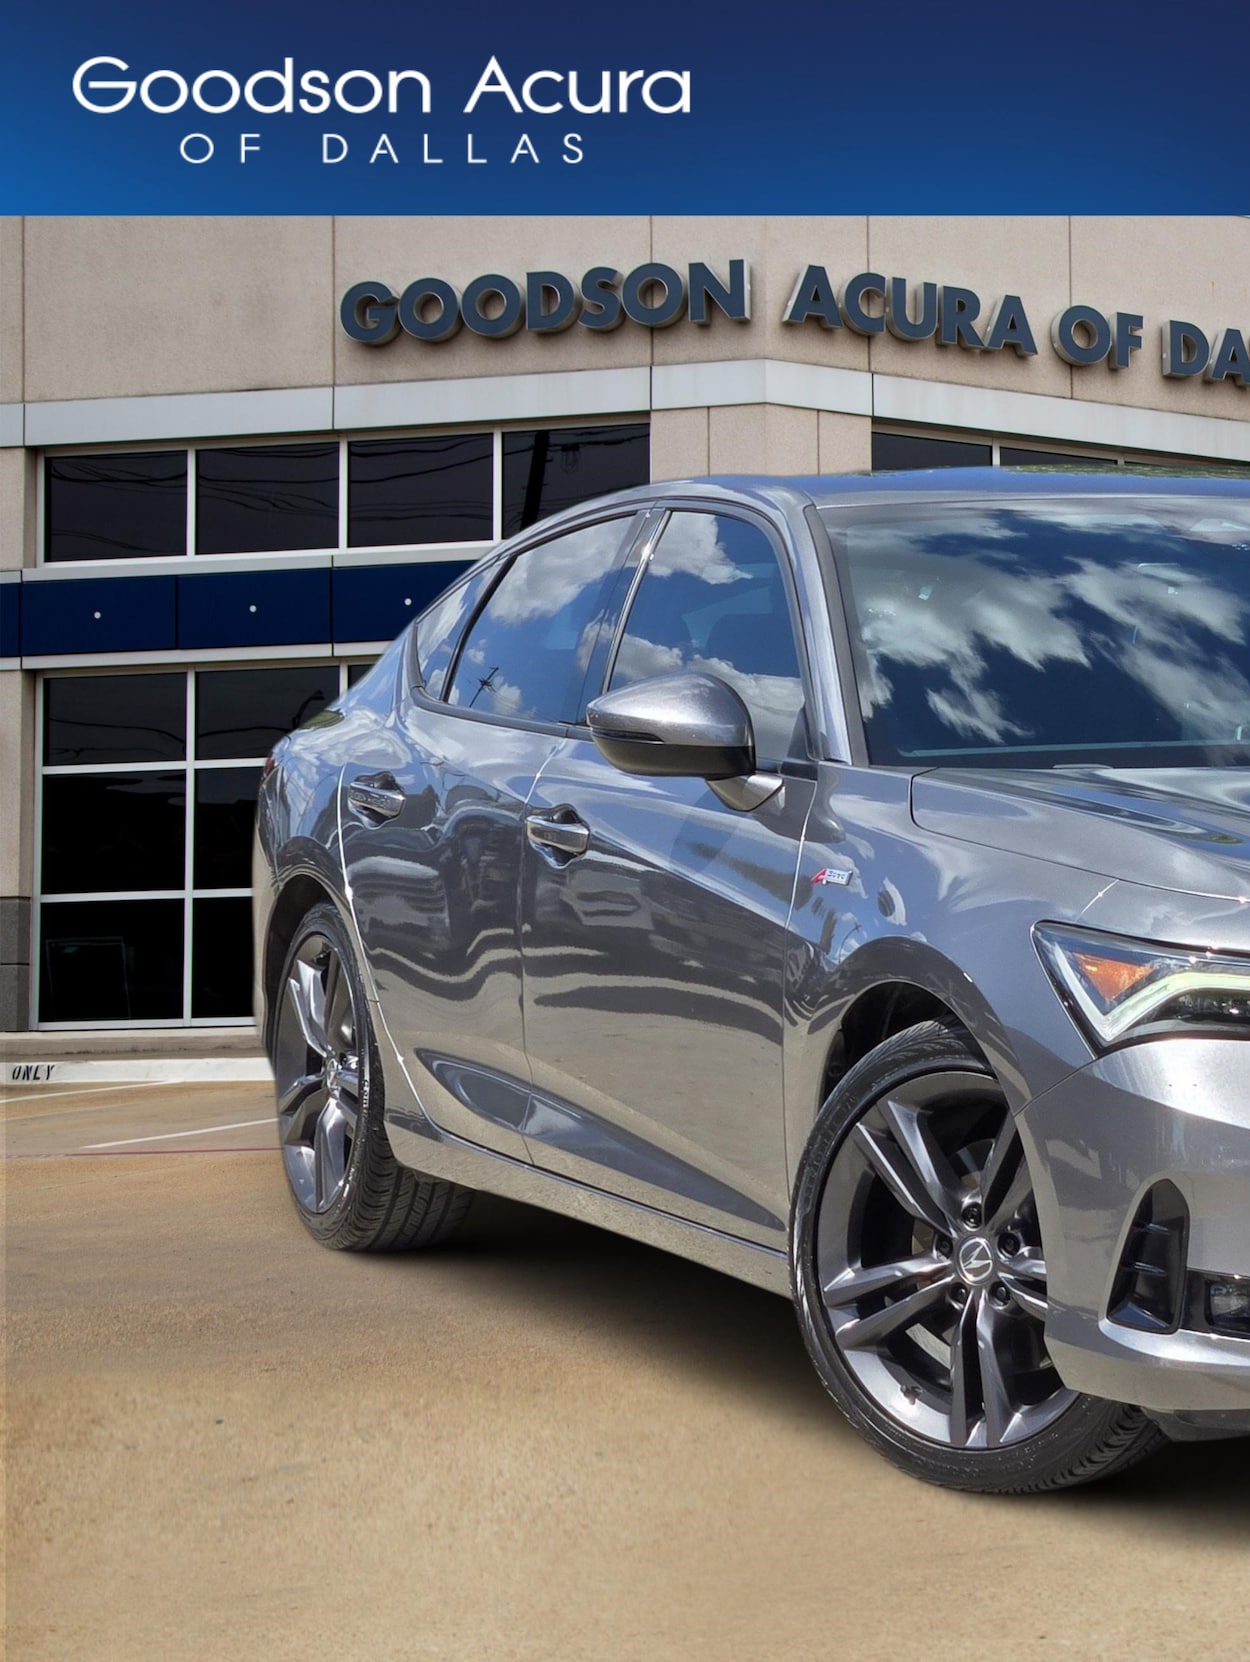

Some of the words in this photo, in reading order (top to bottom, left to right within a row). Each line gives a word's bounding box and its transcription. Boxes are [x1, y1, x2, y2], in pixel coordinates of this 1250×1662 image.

[340, 258, 751, 345] GOODSON
[781, 263, 1039, 357] ACURA
[1051, 304, 1144, 370] OF
[12, 1063, 55, 1081] ONLY
